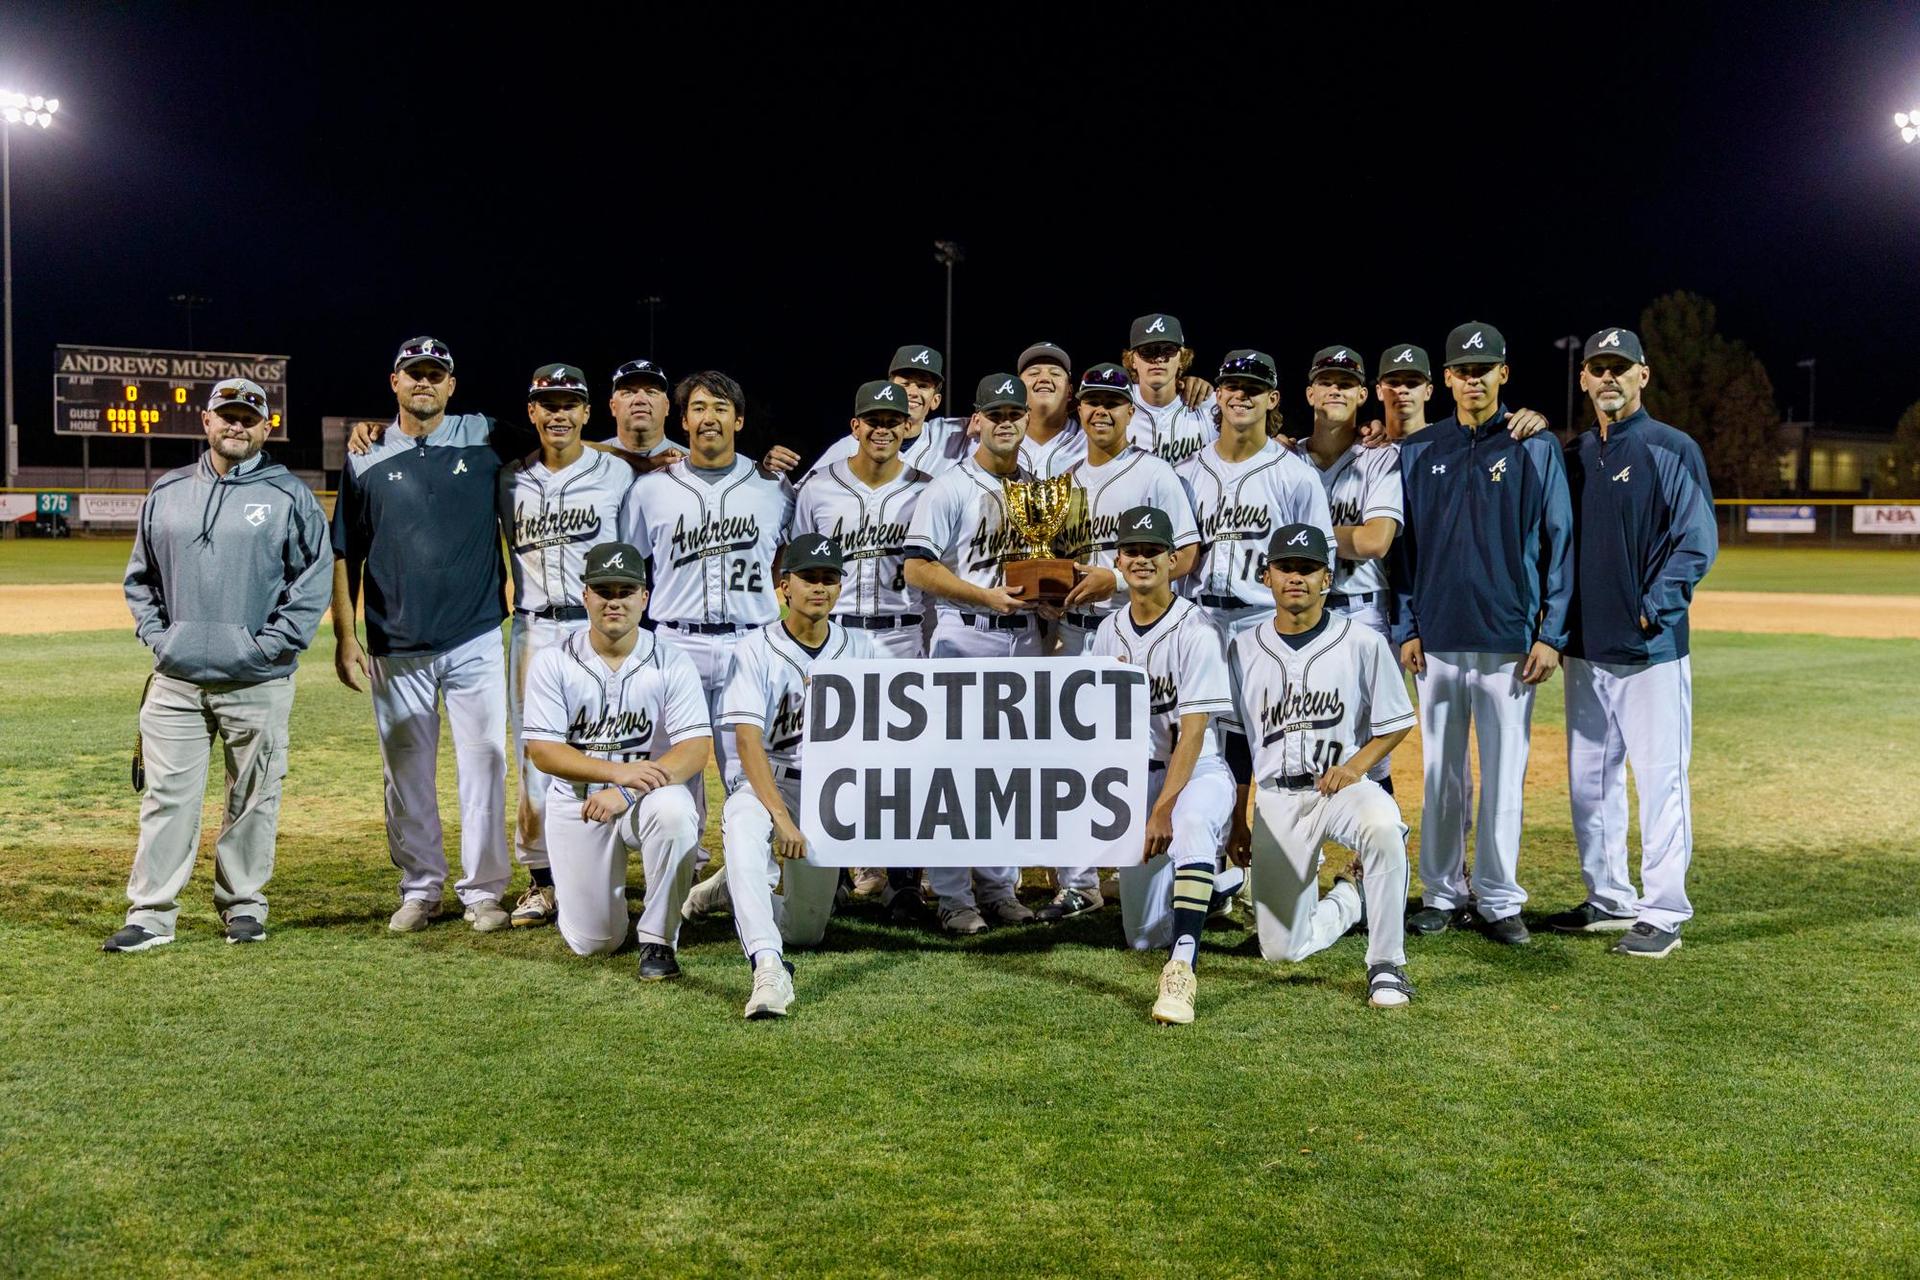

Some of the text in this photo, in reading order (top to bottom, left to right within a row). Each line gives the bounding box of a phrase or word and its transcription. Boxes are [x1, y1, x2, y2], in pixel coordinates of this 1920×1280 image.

[1145, 317, 1164, 333] A
[1462, 331, 1483, 349] A
[911, 350, 929, 365] A
[1393, 349, 1412, 363] A
[60, 354, 281, 381] ANDREWS MUSTANGS
[126, 385, 138, 401] 0
[175, 387, 187, 404] 0
[873, 385, 893, 401] A
[995, 379, 1014, 395] A
[41, 494, 68, 511] 375
[513, 500, 602, 543] Andrews
[1132, 513, 1152, 529] A
[670, 510, 760, 560] Andrews
[1286, 529, 1308, 546] A
[811, 540, 831, 556] A
[853, 549, 886, 559] MUSTANGS
[602, 551, 623, 569] A
[729, 558, 764, 593] 22
[810, 669, 1145, 742] DISTRICT
[1261, 682, 1344, 736] Andrews
[566, 704, 653, 741] Andrews
[818, 767, 1131, 841] CHAMPS
